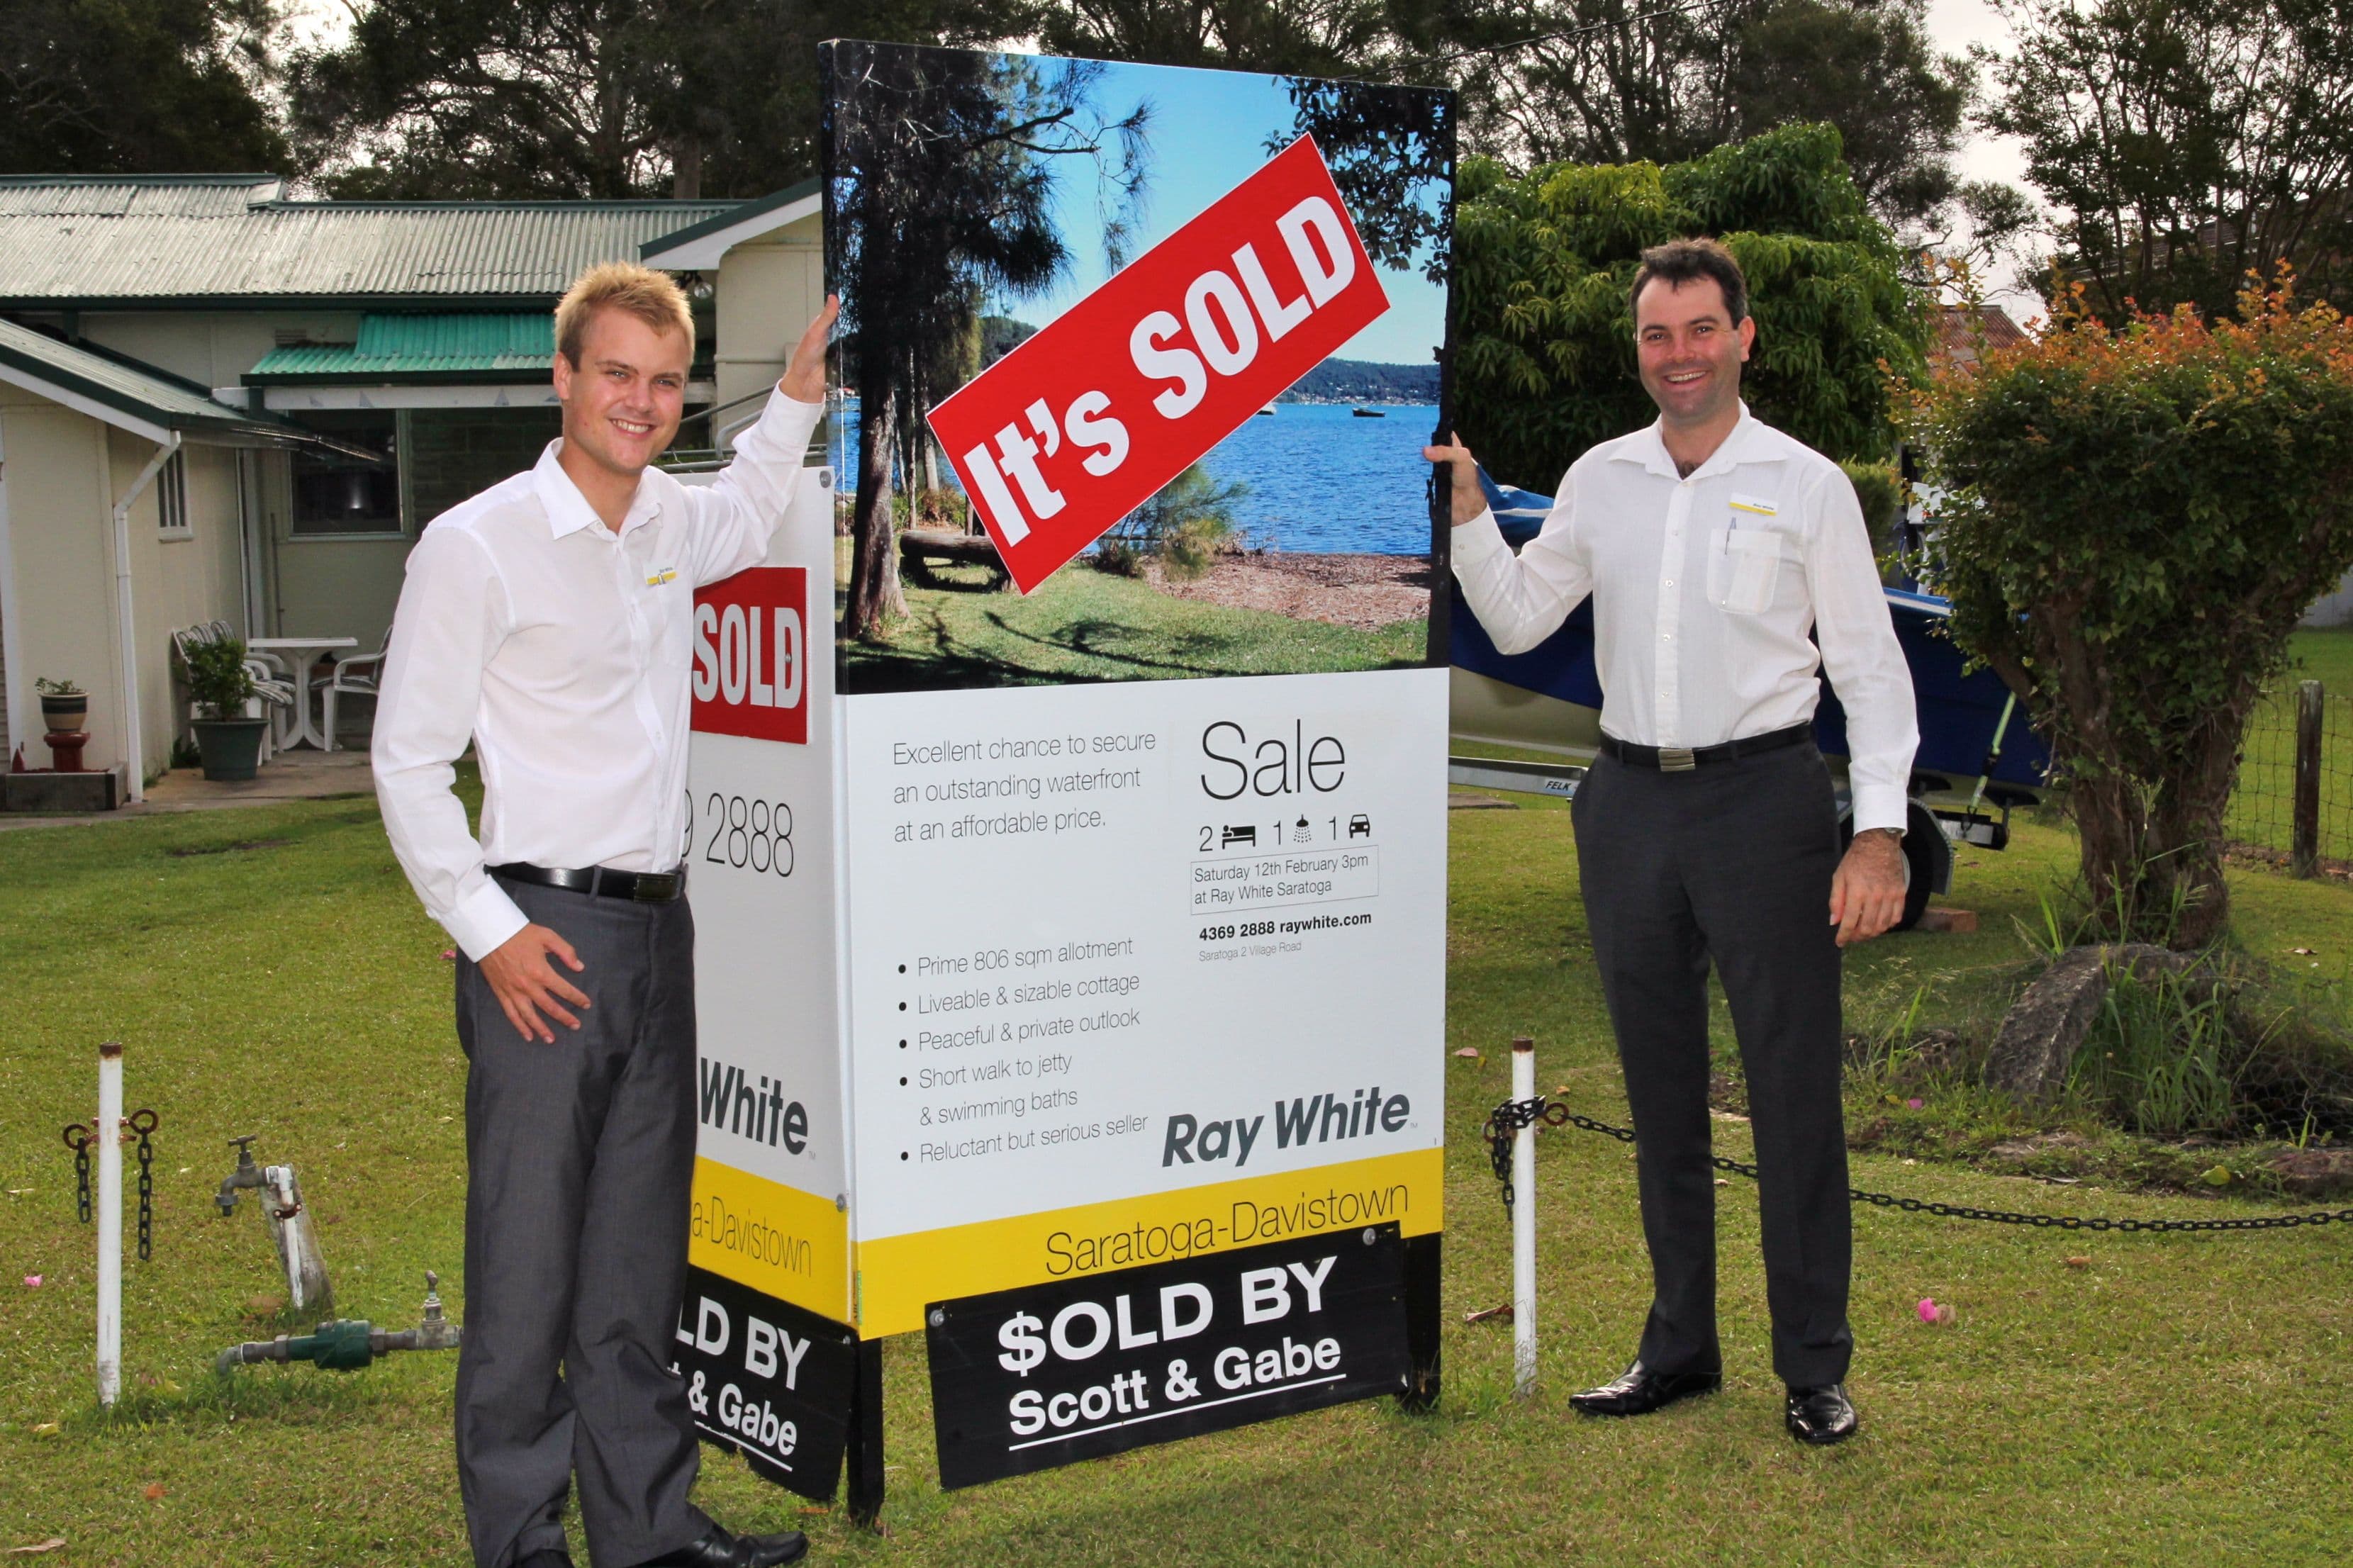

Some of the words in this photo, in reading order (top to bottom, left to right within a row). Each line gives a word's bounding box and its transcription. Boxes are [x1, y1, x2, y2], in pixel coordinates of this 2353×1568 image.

[963, 390, 1130, 547] It's
[1129, 196, 1356, 420] SOLD
[693, 603, 803, 709] SOLD
[894, 740, 982, 765] Excellent
[989, 737, 1061, 759] chance
[1067, 734, 1085, 754] to
[1092, 734, 1156, 753] secure
[1201, 719, 1345, 800] Sale
[894, 786, 917, 804] an
[926, 774, 1040, 801] outstanding
[1047, 768, 1140, 793] waterfront
[1546, 780, 1572, 791] FELK
[707, 793, 793, 877] 2888
[895, 821, 913, 842] at
[920, 823, 944, 840] an
[952, 811, 1048, 838] affordable
[1056, 808, 1105, 834] price.
[1200, 826, 1213, 851] 2
[1273, 821, 1280, 845] 1
[1329, 817, 1336, 840] 1
[1195, 866, 1250, 882] Saturday
[1256, 862, 1281, 876] 12th
[1286, 859, 1338, 873] February
[1342, 855, 1368, 870] 3pm
[1195, 891, 1207, 905] at
[1212, 889, 1234, 904] Ray
[1239, 885, 1273, 900] White
[1278, 881, 1331, 896] Saratoga
[1200, 925, 1235, 941] 4369
[1240, 921, 1275, 936] 2888
[1280, 914, 1371, 934] raywhite.com
[919, 956, 968, 976] Prime
[975, 949, 1008, 970] 806
[1015, 949, 1051, 968] sqm
[1058, 937, 1132, 962] allotment
[1199, 950, 1238, 961] Saratoga
[1241, 947, 1246, 956] 2
[1249, 946, 1277, 956] Village
[1279, 941, 1302, 952] Road
[920, 989, 990, 1014] Liveable
[996, 987, 1008, 1005] &
[1015, 980, 1071, 1003] sizable
[1078, 976, 1139, 996] cottage
[920, 1024, 993, 1051] Peaceful
[1001, 1023, 1012, 1041] &
[1019, 1017, 1073, 1043] private
[1080, 1008, 1140, 1031] outlook
[920, 1066, 966, 1088] Short
[972, 1060, 1011, 1081] walk
[1016, 1058, 1032, 1075] to
[1037, 1053, 1072, 1077] jetty
[701, 1057, 807, 1155] White
[920, 1107, 932, 1126] &
[939, 1097, 1024, 1123] swimming
[1032, 1089, 1078, 1110] baths
[1162, 1114, 1265, 1167] Ray
[1275, 1087, 1409, 1149] White
[921, 1134, 1002, 1163] Reluctant
[1009, 1130, 1035, 1150] but
[1041, 1124, 1100, 1145] serious
[1106, 1115, 1148, 1136] seller
[692, 1195, 812, 1278] a-Davistown
[1045, 1182, 1409, 1275] Saratoga-Davistown
[997, 1282, 1213, 1377] $OLD
[1239, 1255, 1338, 1326] BY
[744, 1315, 811, 1391] BY
[1008, 1370, 1148, 1437] Scott
[1163, 1358, 1202, 1402] &
[1214, 1335, 1342, 1391] Gabe
[688, 1370, 708, 1416] &
[718, 1383, 797, 1456] Gabe
